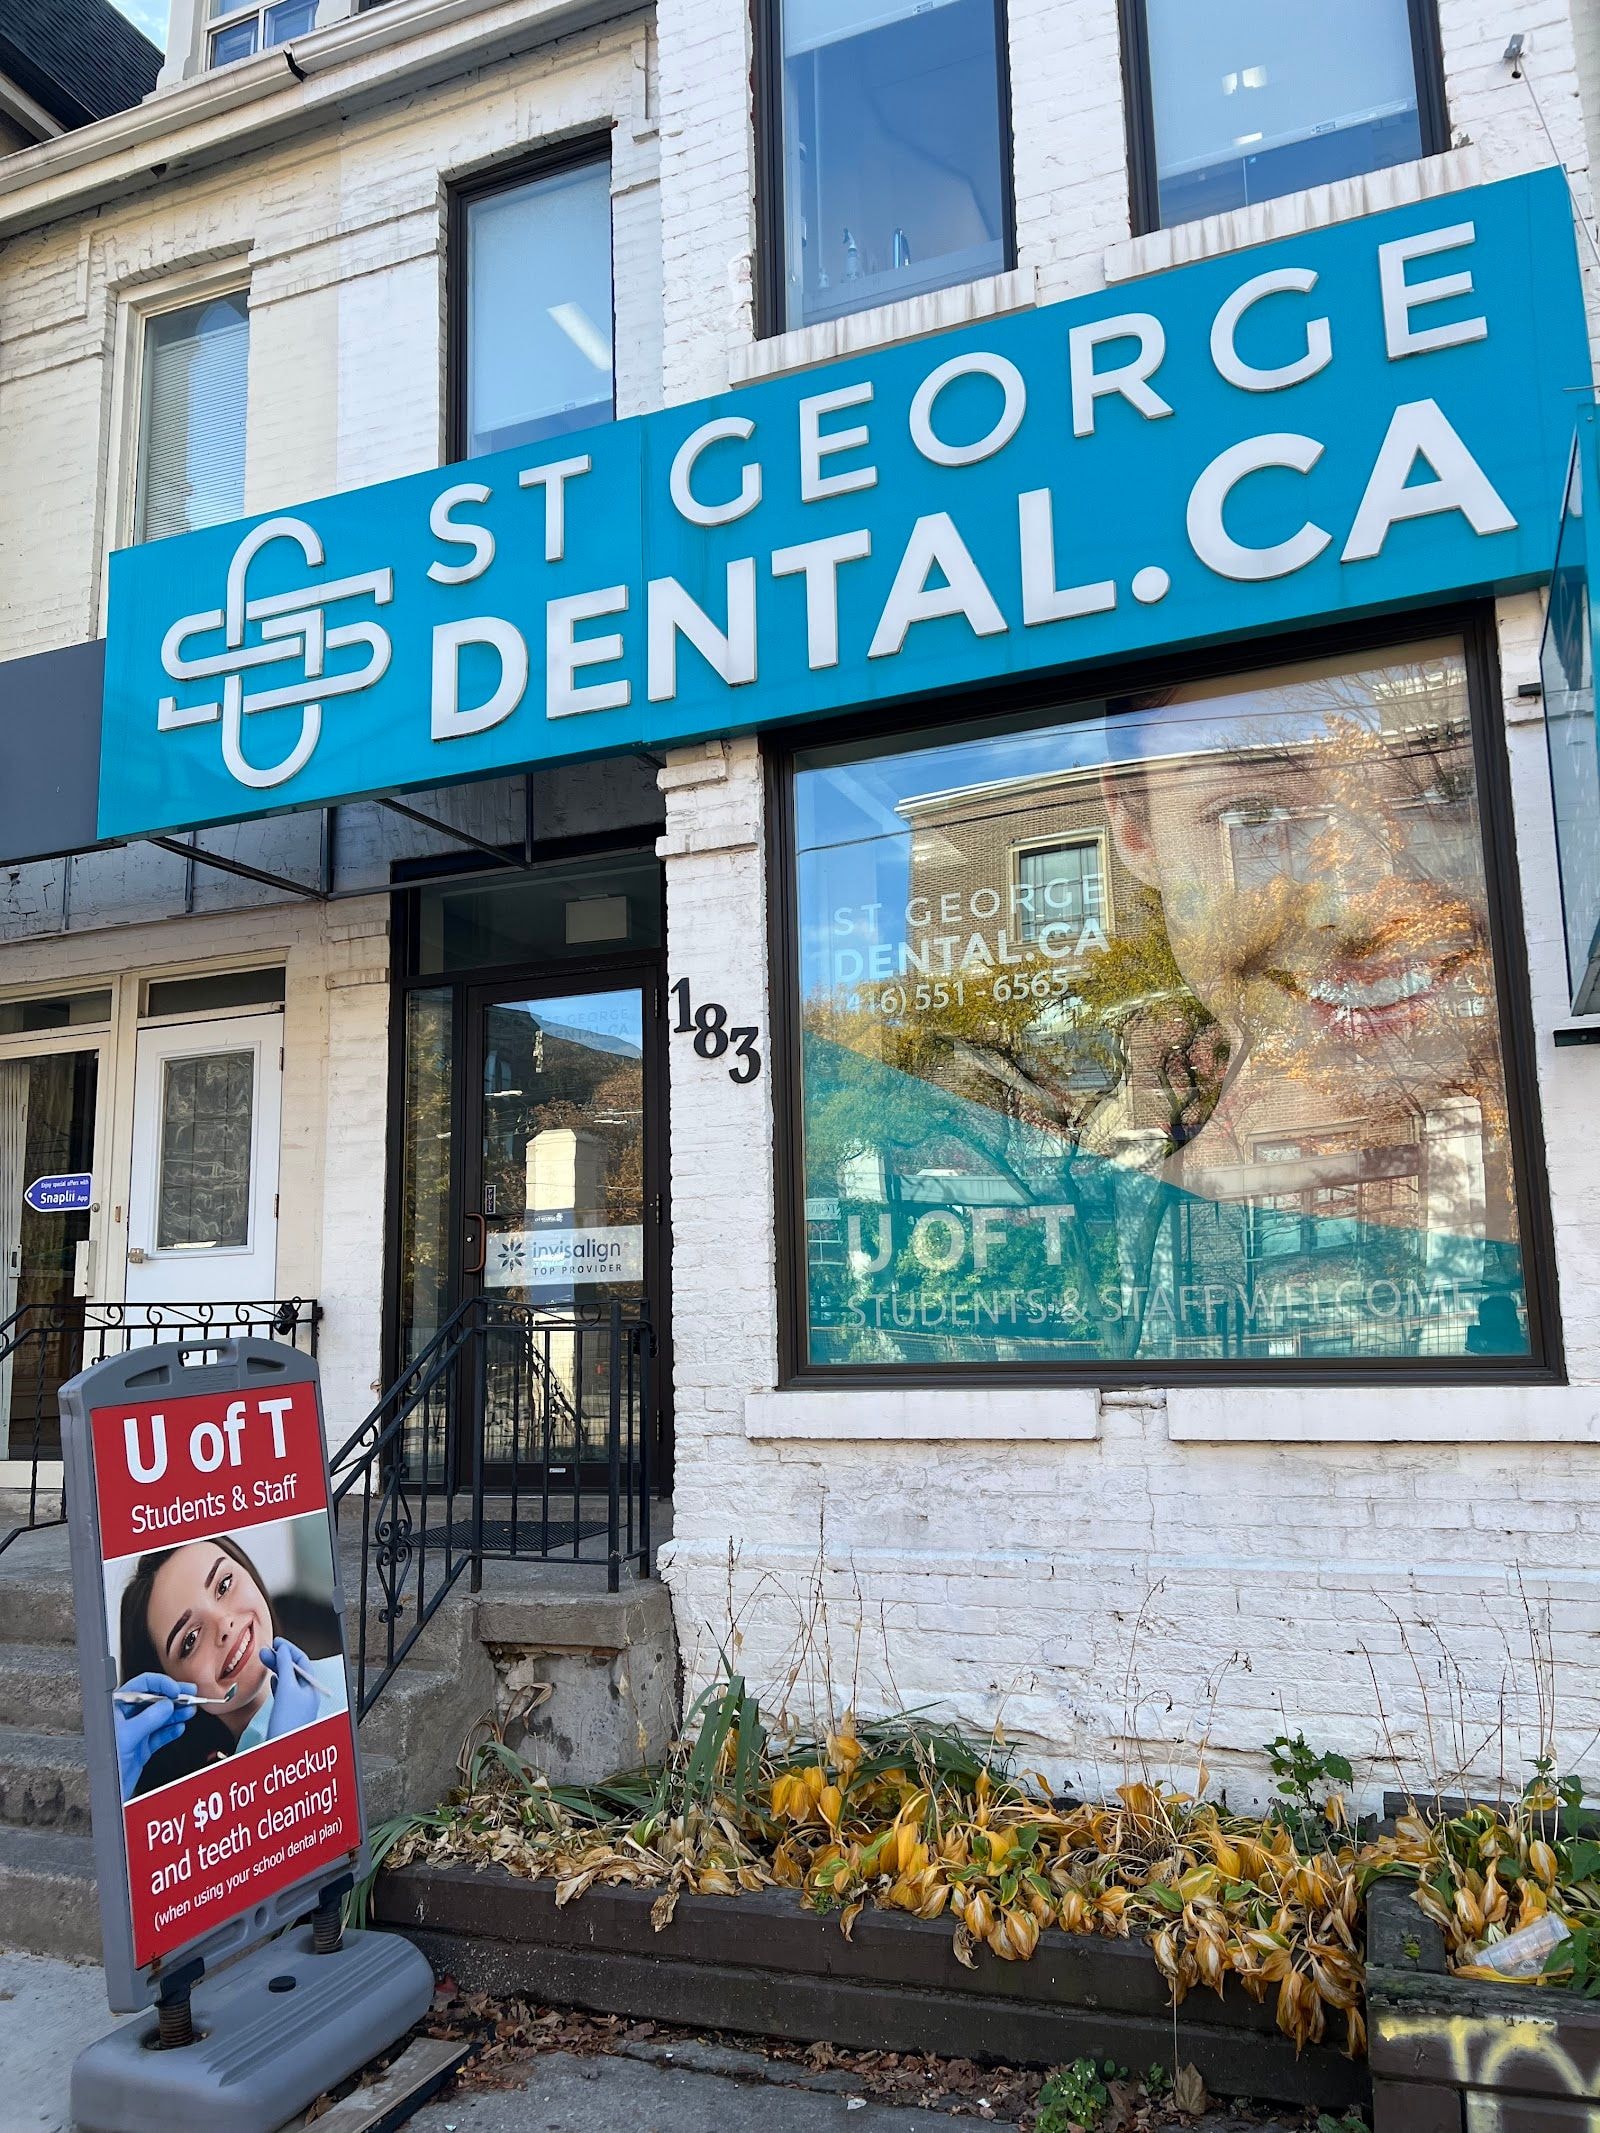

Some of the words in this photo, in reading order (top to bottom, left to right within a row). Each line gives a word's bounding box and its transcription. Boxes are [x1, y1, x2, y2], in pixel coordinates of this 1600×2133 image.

[426, 454, 592, 585] ST
[669, 220, 1488, 527] GEORGE
[431, 397, 1519, 742] DENTAL.CA
[833, 902, 882, 936] ST
[905, 872, 1105, 928] GEORGE
[834, 918, 1111, 983] DENTAL.CA
[915, 980, 964, 1011] 551
[993, 968, 1069, 1002] 6565
[671, 977, 761, 1084] 183
[40, 1190, 75, 1205] Snaplii
[533, 1238, 621, 1262] invisalign
[533, 1267, 556, 1275] TOP
[562, 1264, 622, 1274] PROVIDER
[848, 1213, 893, 1273] U
[848, 1288, 1046, 1328] STUDENTS
[1063, 1287, 1089, 1324] &
[1102, 1284, 1224, 1323] STAFF
[1231, 1276, 1475, 1320] WELCOME
[124, 1415, 168, 1484] U
[189, 1401, 246, 1473] of
[258, 1397, 293, 1458] T
[131, 1491, 226, 1534] Students
[231, 1485, 249, 1512] &
[253, 1473, 297, 1507] Staff
[146, 1813, 186, 1851] Pay
[193, 1791, 224, 1832] $0
[229, 1780, 258, 1811] for
[263, 1744, 338, 1795] checkup
[150, 1848, 192, 1895] and
[198, 1822, 252, 1870] teeth
[257, 1778, 339, 1840] cleaning!
[154, 1900, 191, 1931] (when
[194, 1881, 224, 1907] using
[226, 1867, 251, 1893] your
[253, 1846, 285, 1877] school
[287, 1832, 317, 1858] dental
[319, 1817, 343, 1845] plan)
